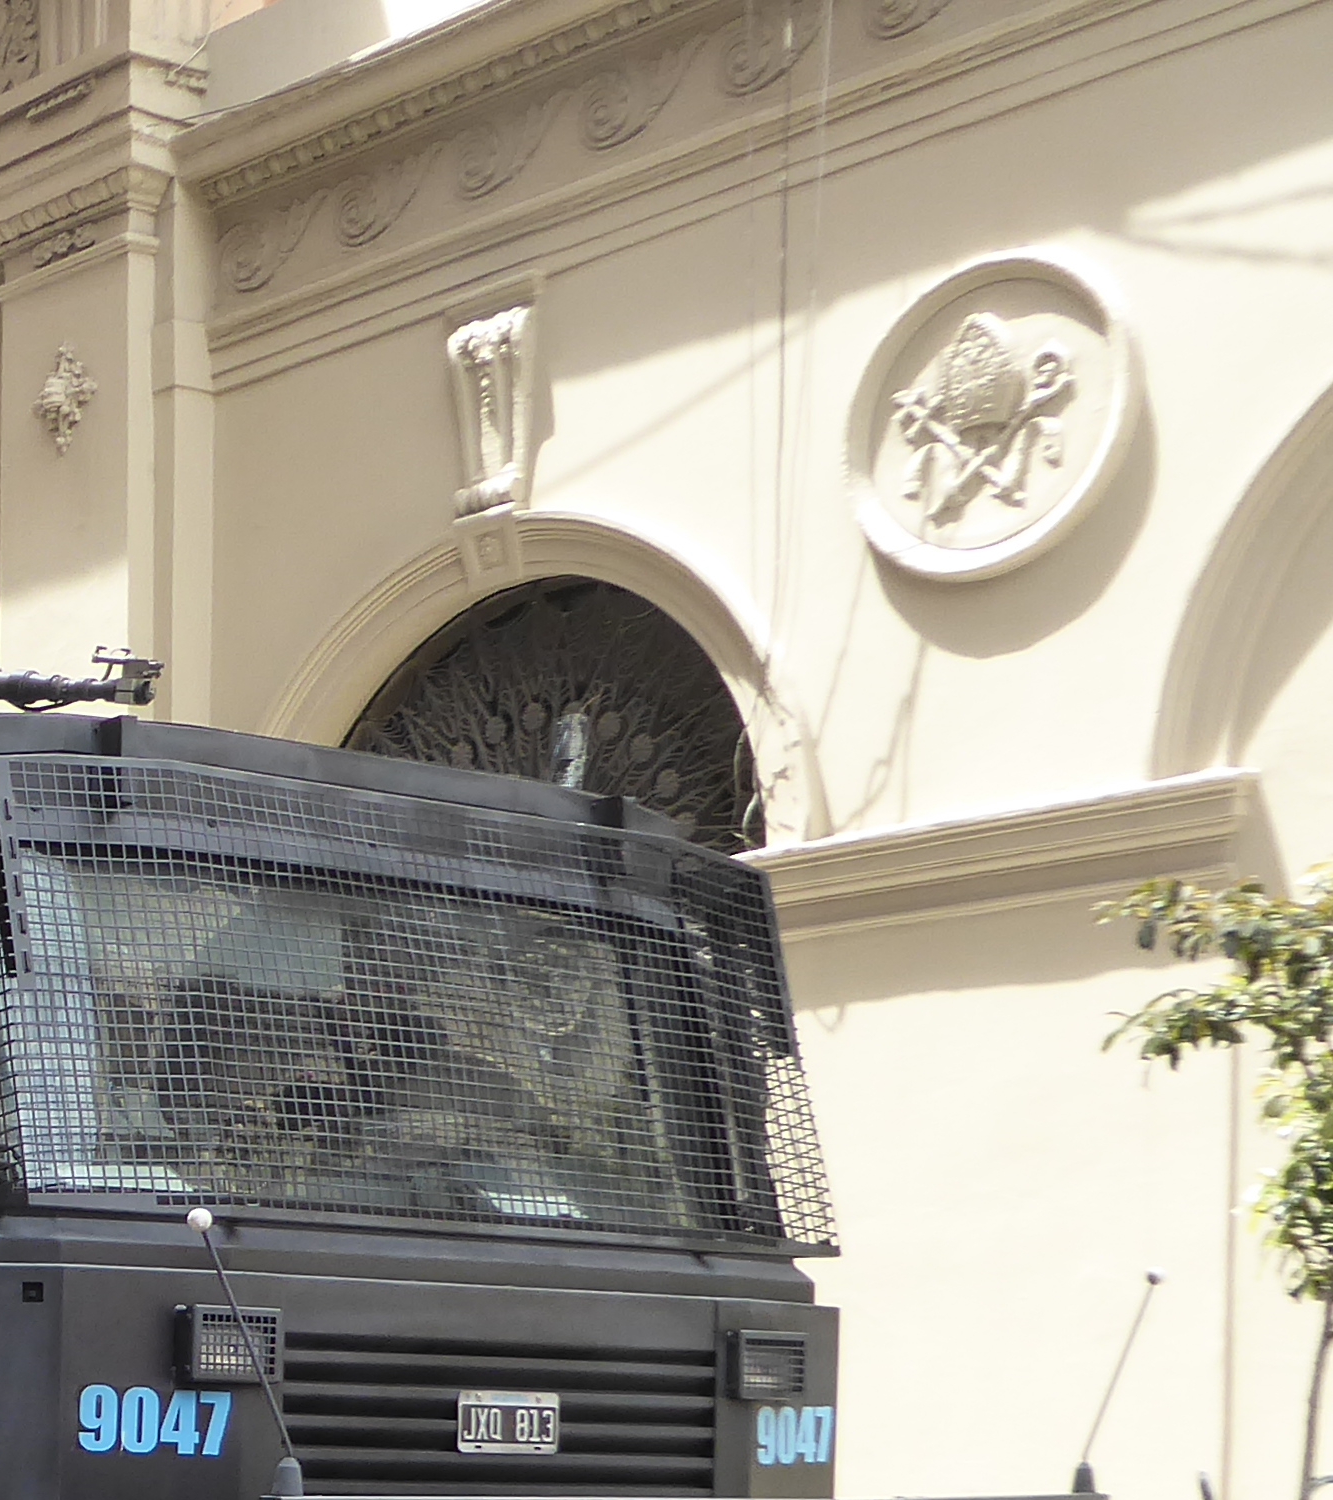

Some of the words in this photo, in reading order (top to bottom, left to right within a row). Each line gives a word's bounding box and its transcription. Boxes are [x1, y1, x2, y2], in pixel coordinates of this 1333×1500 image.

[78, 1384, 232, 1456] 9047
[463, 1407, 502, 1441] JXQ
[515, 1409, 554, 1442] 813
[757, 1406, 833, 1465] 9047
